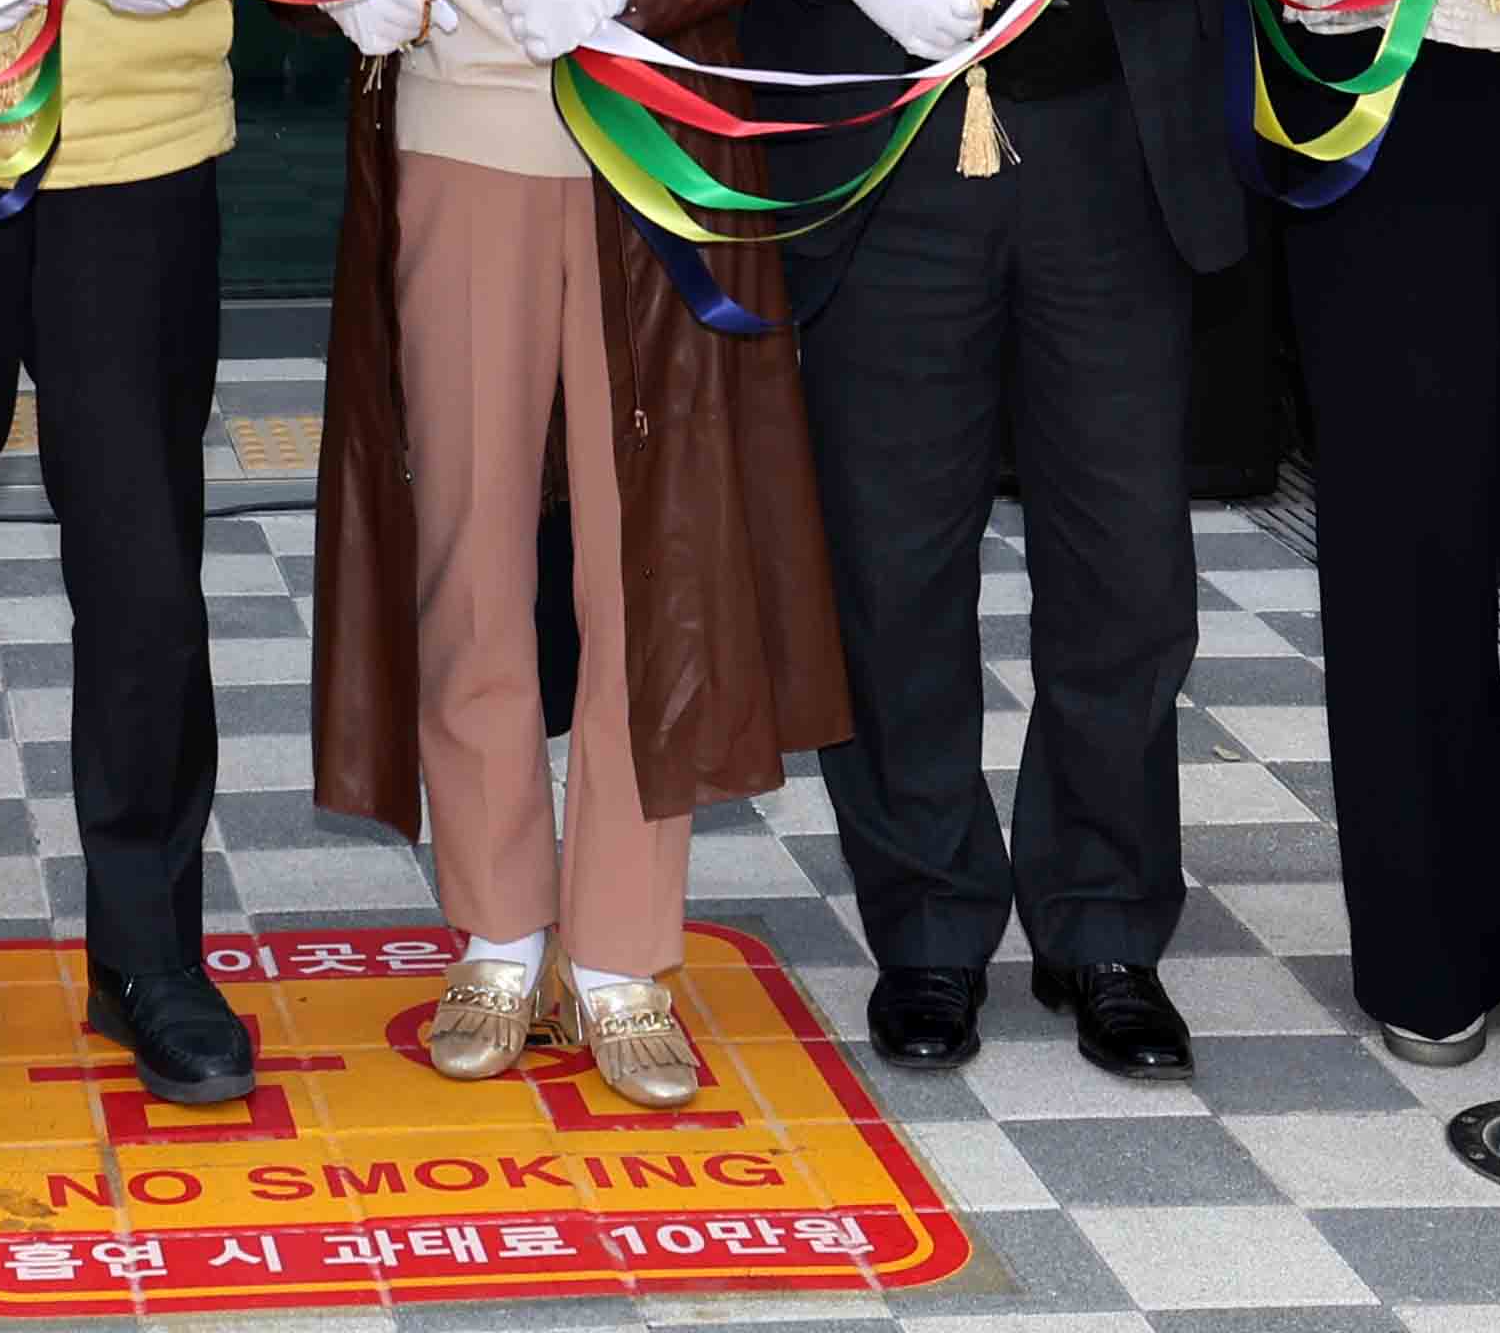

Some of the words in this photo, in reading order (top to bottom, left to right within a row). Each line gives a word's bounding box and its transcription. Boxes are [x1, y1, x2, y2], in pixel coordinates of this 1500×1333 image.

[205, 939, 453, 980] 이곳은
[47, 1165, 203, 1208] NO
[249, 1150, 787, 1201] SMOKING
[3, 1238, 168, 1280] 흡연
[217, 1233, 283, 1275] 시
[328, 1226, 577, 1268] 과태료
[607, 1214, 876, 1257] 10만원
